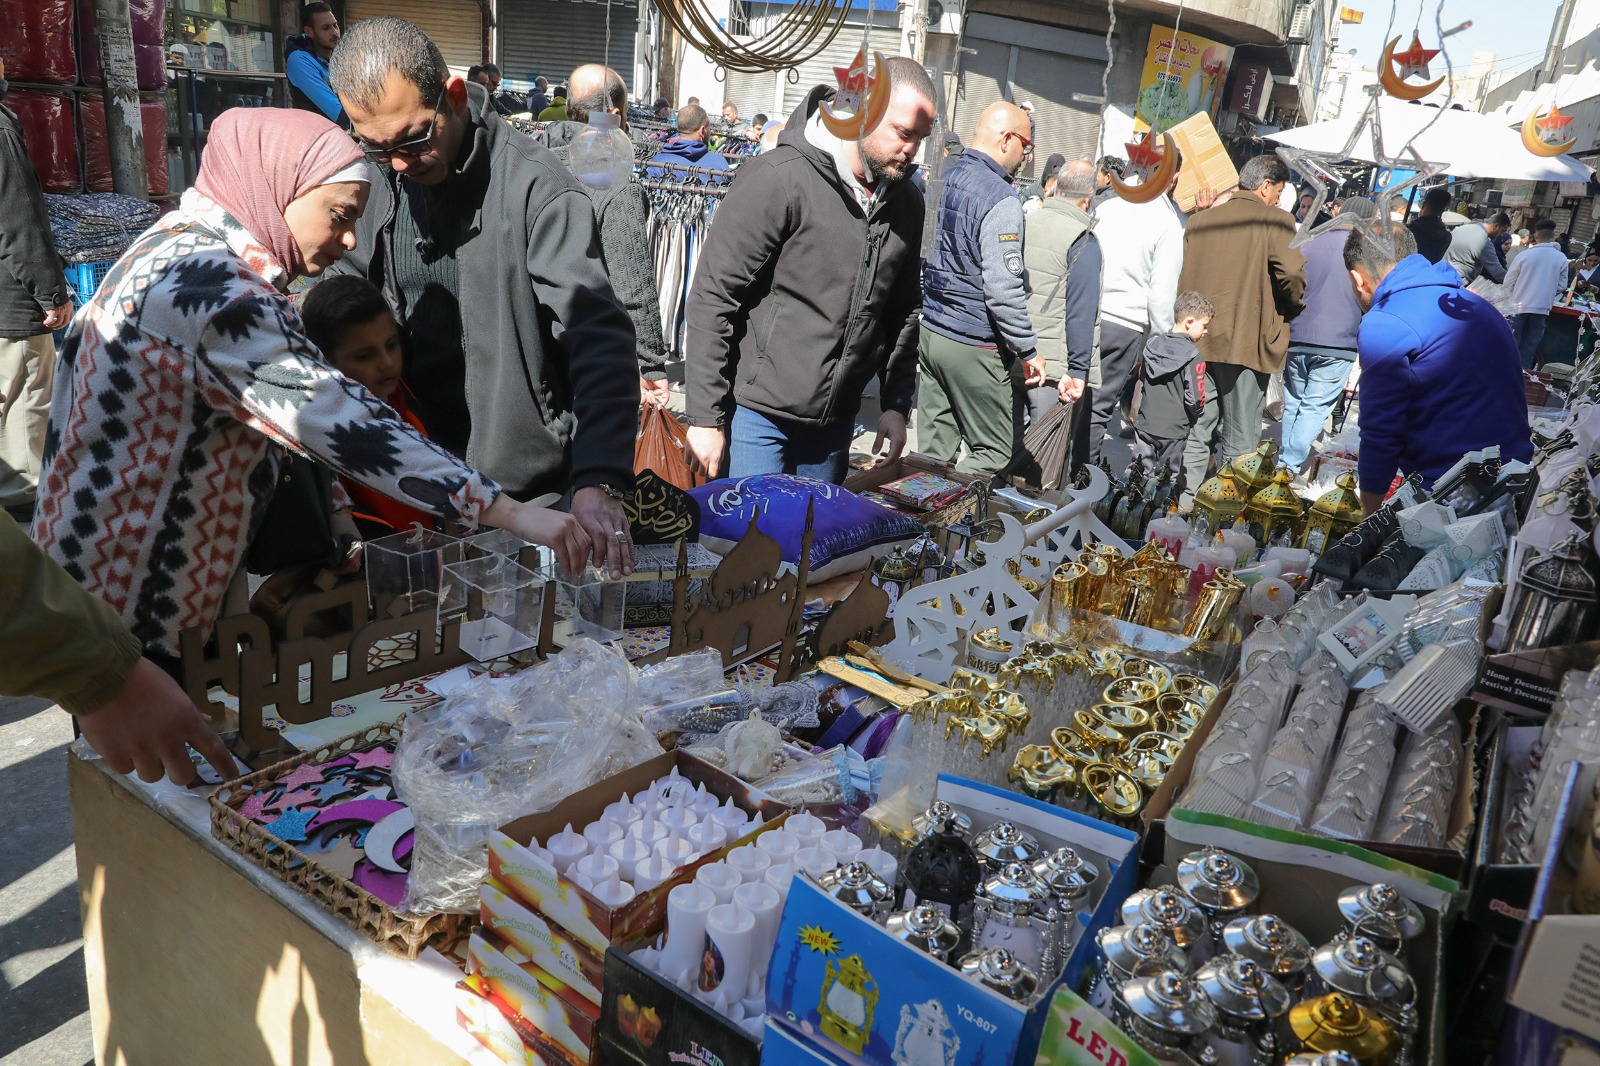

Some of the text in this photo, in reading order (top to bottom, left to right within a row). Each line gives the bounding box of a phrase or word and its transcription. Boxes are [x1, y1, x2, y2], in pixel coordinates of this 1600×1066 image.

[634, 485, 694, 540] رمضان
[1480, 677, 1513, 693] Festival
[1486, 669, 1511, 682] Home
[807, 933, 829, 946] NEW
[957, 1003, 998, 1035] YQ-807
[1066, 1016, 1128, 1066] LED
